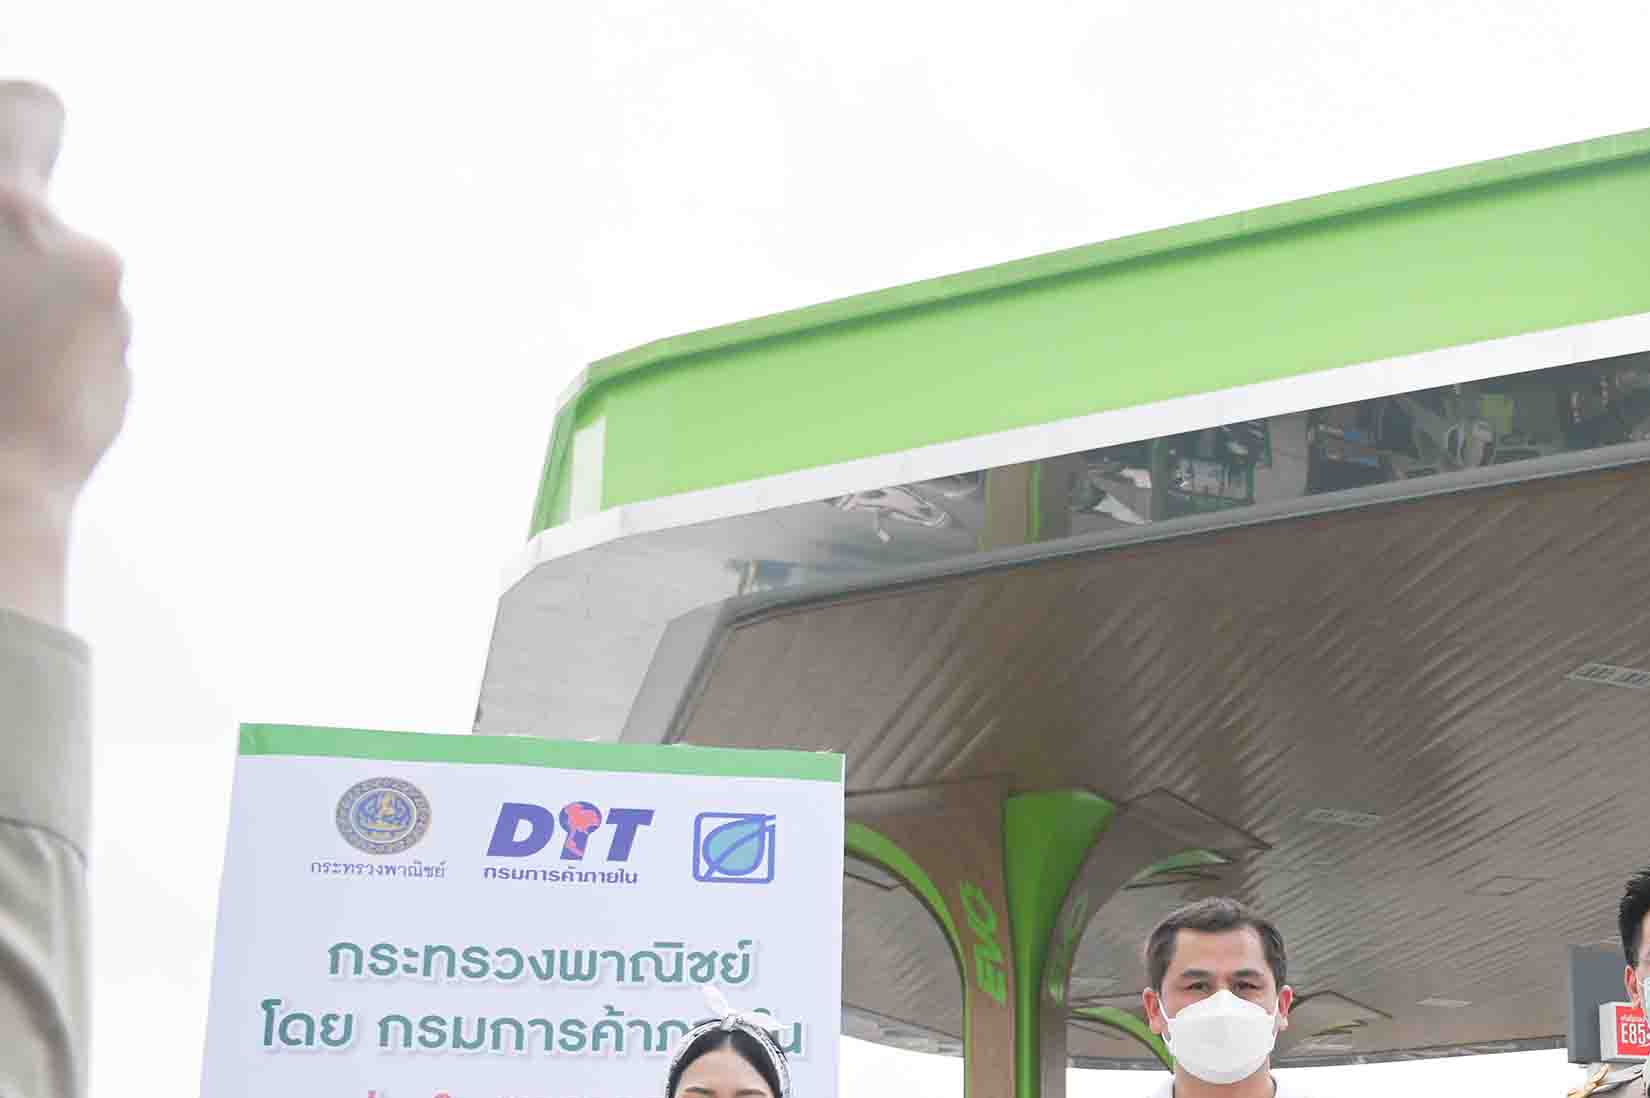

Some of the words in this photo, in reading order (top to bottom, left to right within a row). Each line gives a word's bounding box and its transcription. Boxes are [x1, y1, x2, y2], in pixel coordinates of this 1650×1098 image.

[486, 801, 654, 862] DIT
[310, 859, 446, 879] กระทรวงพาณิชย์
[482, 864, 638, 885] กรมการค้าภายใน
[328, 940, 753, 984] กระทรวงพาณิชย์
[261, 999, 355, 1049] โดย
